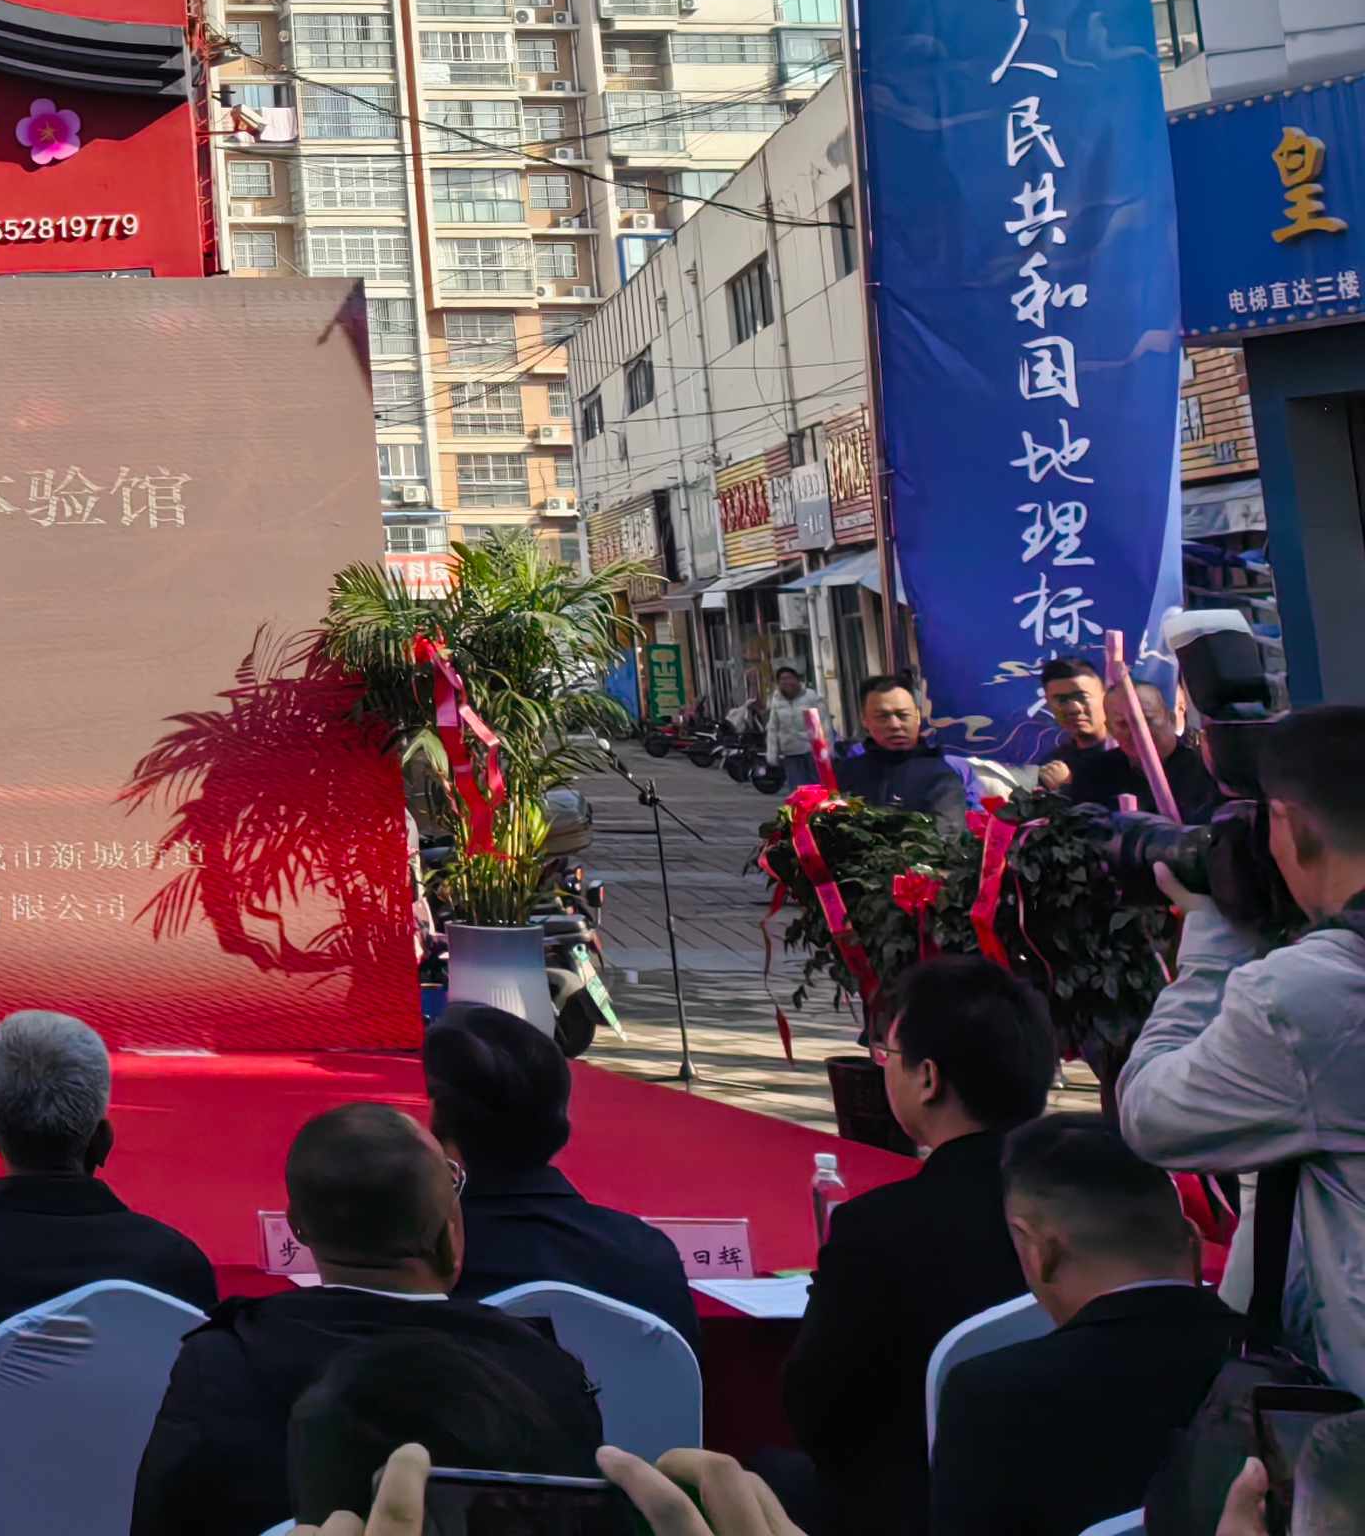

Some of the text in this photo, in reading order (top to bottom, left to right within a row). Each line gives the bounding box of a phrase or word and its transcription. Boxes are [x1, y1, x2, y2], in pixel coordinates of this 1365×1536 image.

[1271, 126, 1350, 245] 皇
[1229, 269, 1361, 314] 电梯直达三楼
[682, 1245, 745, 1273] 日辉
